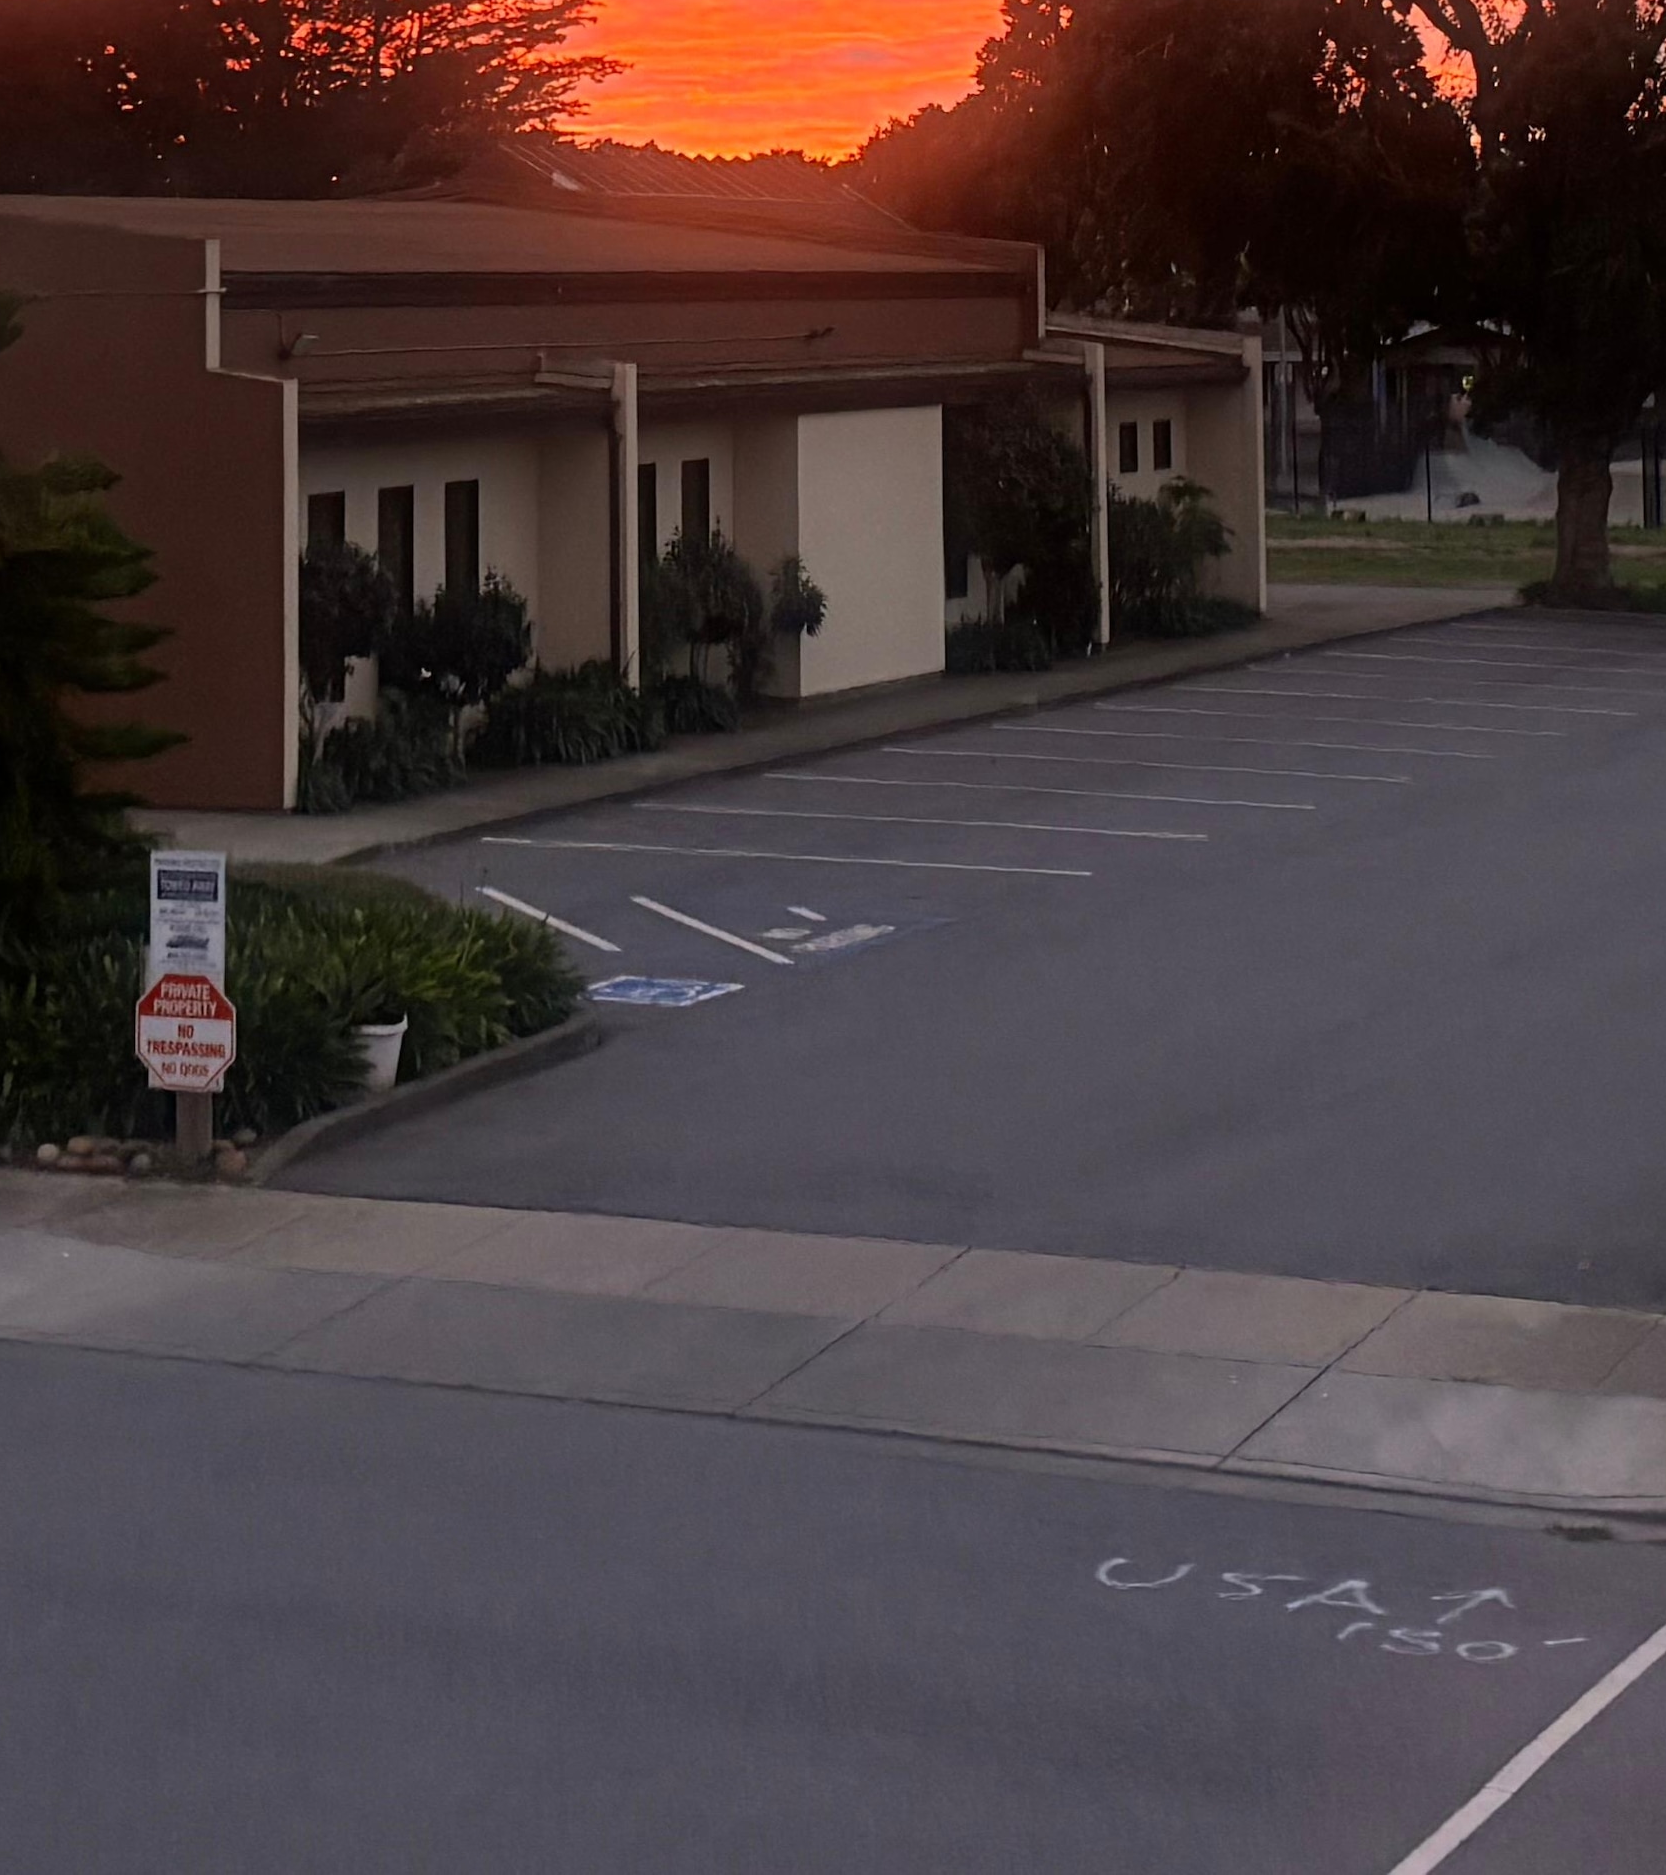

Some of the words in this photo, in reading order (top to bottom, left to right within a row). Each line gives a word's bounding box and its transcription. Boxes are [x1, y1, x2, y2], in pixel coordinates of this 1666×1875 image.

[160, 982, 211, 1001] PRIVATE
[153, 998, 217, 1017] PROPERTY
[177, 1024, 194, 1039] NO
[147, 1039, 226, 1059] TRESPASSING
